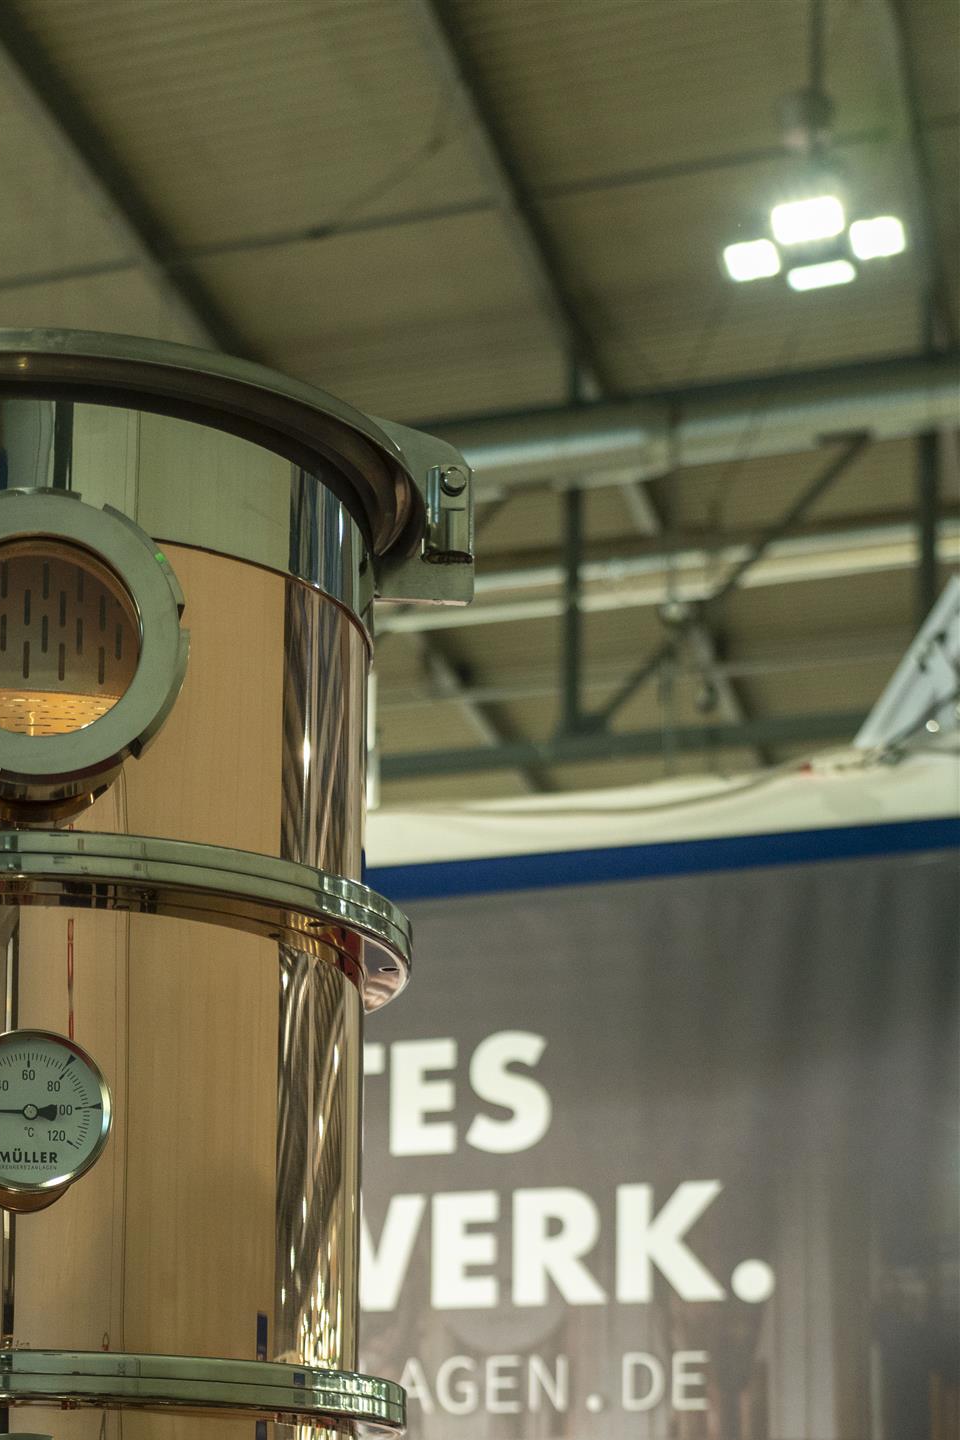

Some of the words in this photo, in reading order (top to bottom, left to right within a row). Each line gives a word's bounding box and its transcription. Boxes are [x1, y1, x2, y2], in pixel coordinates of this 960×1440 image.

[22, 1069, 36, 1081] 60
[47, 1080, 61, 1092] 80
[56, 1104, 73, 1116] 00
[47, 1130, 66, 1142] 120
